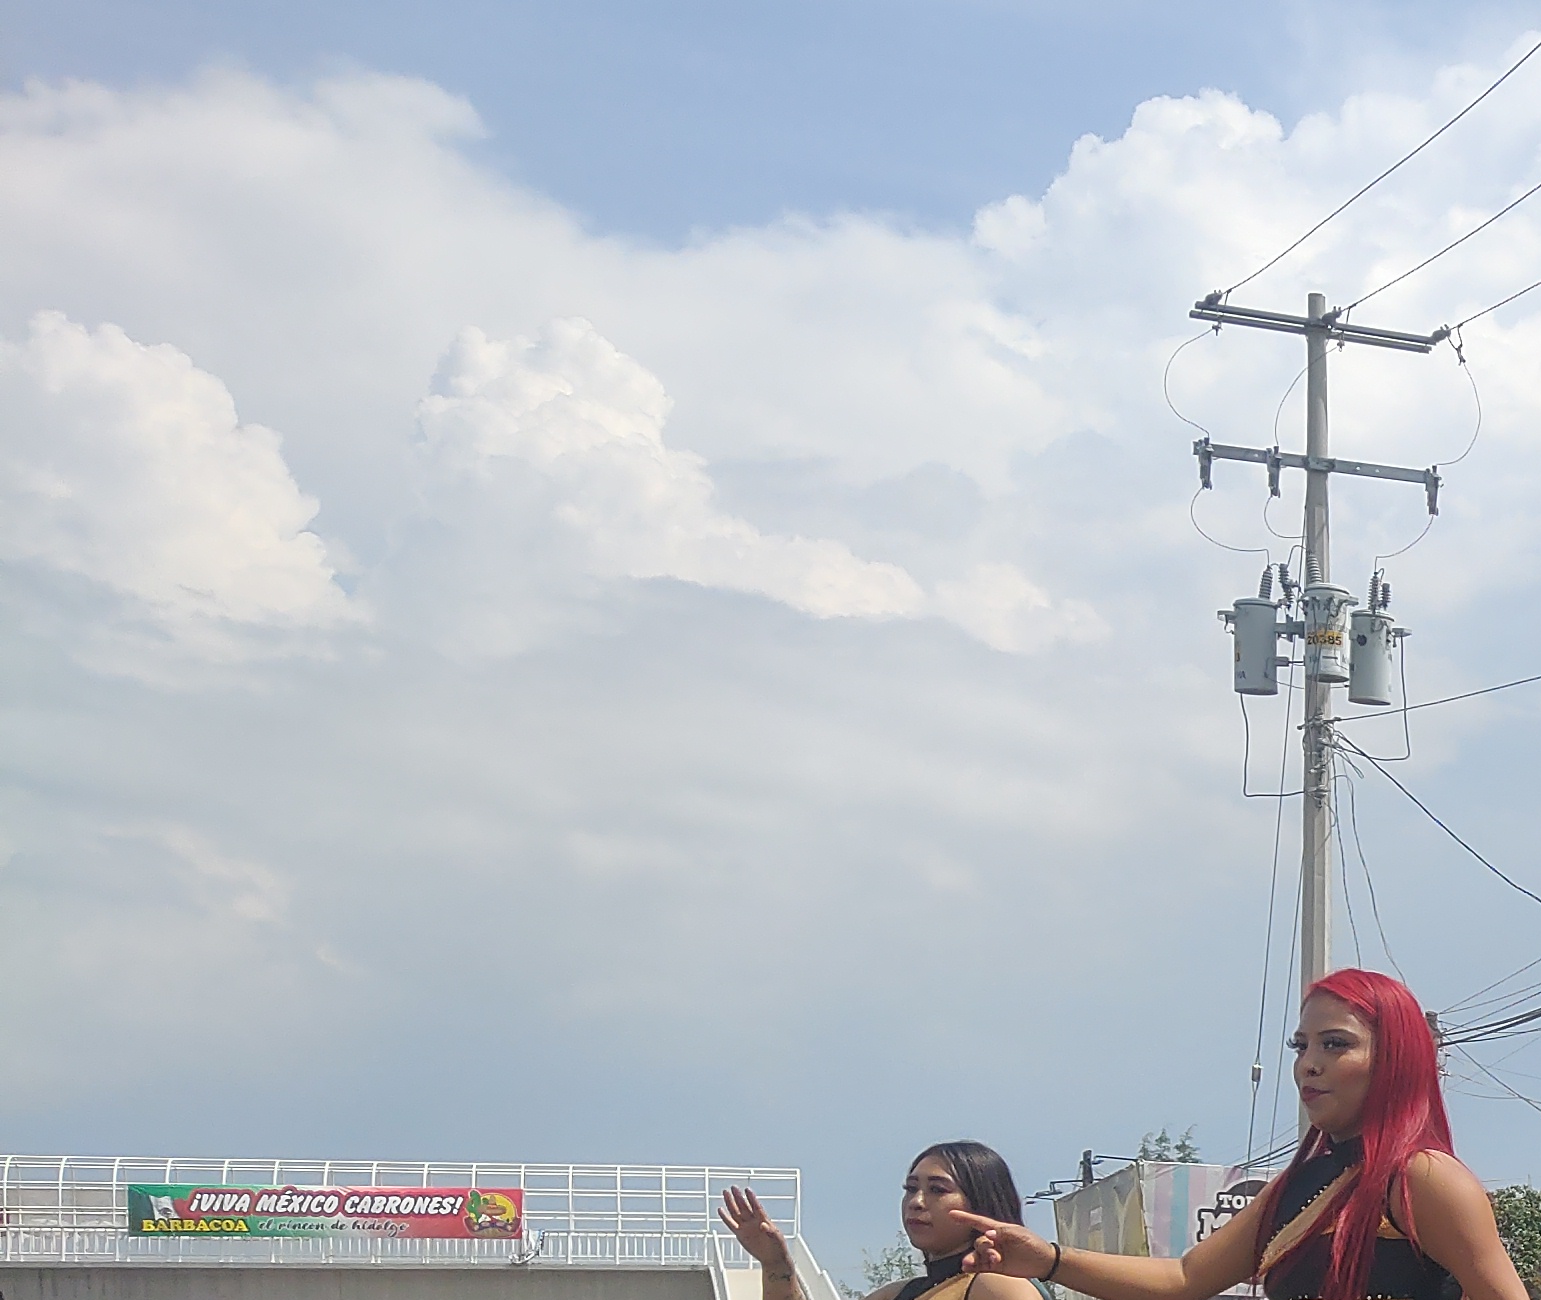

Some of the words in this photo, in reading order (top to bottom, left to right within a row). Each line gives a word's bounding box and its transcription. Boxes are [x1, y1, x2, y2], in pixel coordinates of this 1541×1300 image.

[191, 1191, 249, 1213] ¡VIVA
[256, 1190, 339, 1214] MÉXICO
[345, 1194, 463, 1216] CABRONES!
[142, 1219, 248, 1232] BARBACOA
